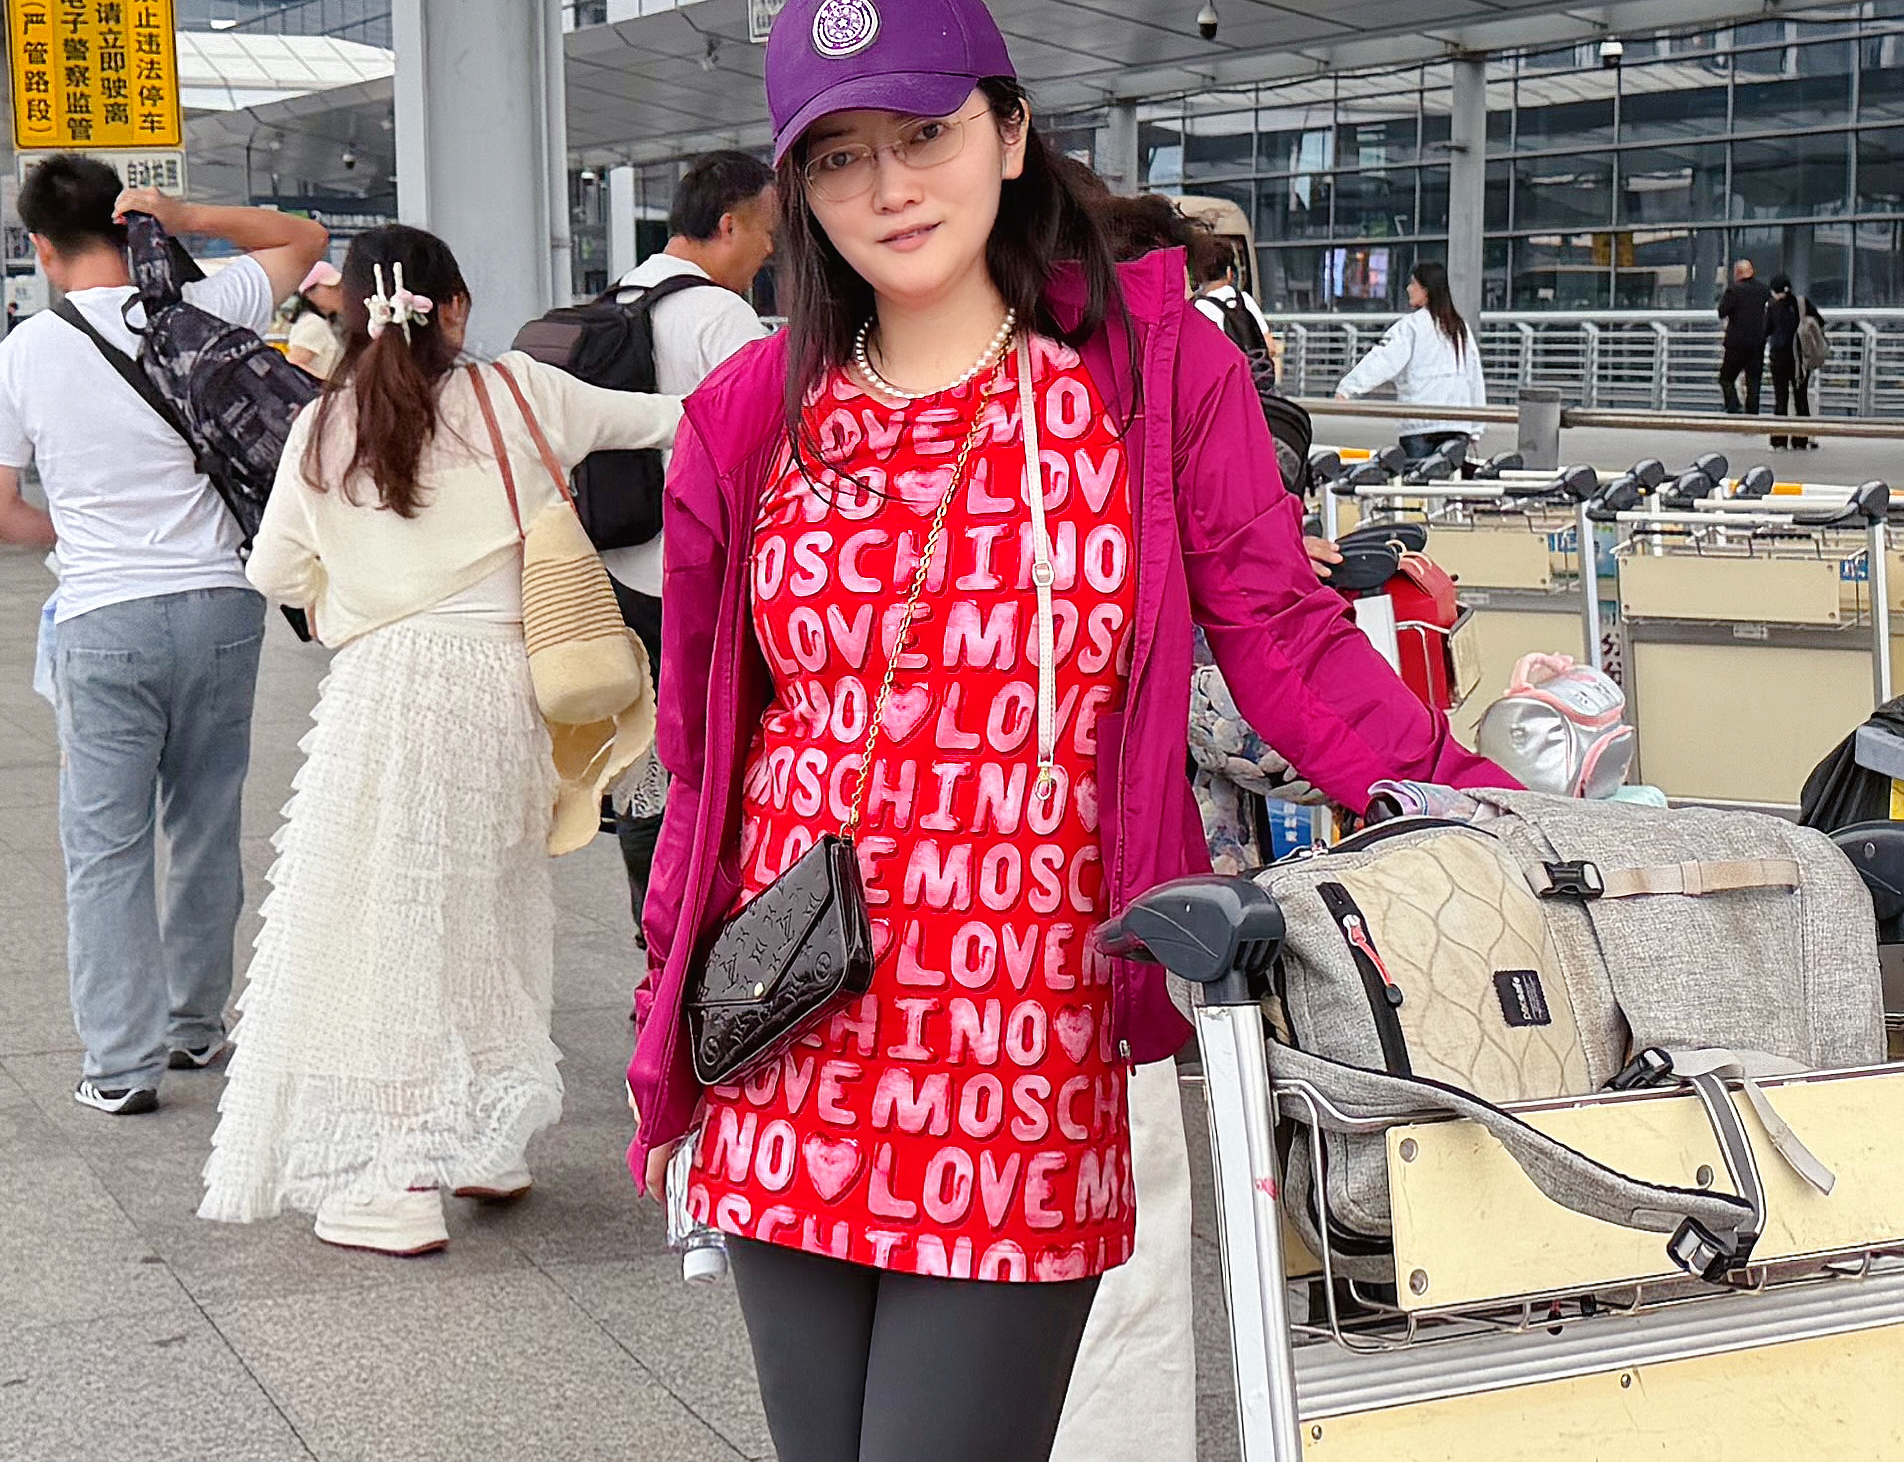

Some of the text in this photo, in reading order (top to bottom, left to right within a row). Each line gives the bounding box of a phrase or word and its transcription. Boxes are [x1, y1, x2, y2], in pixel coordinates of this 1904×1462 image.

[96, 1, 130, 125] 请立即驶离
[760, 598, 1136, 677] LOVE MOS
[896, 919, 1077, 992] LOVE
[802, 995, 1049, 1066] HINO
[867, 1140, 1070, 1230] LOVE
